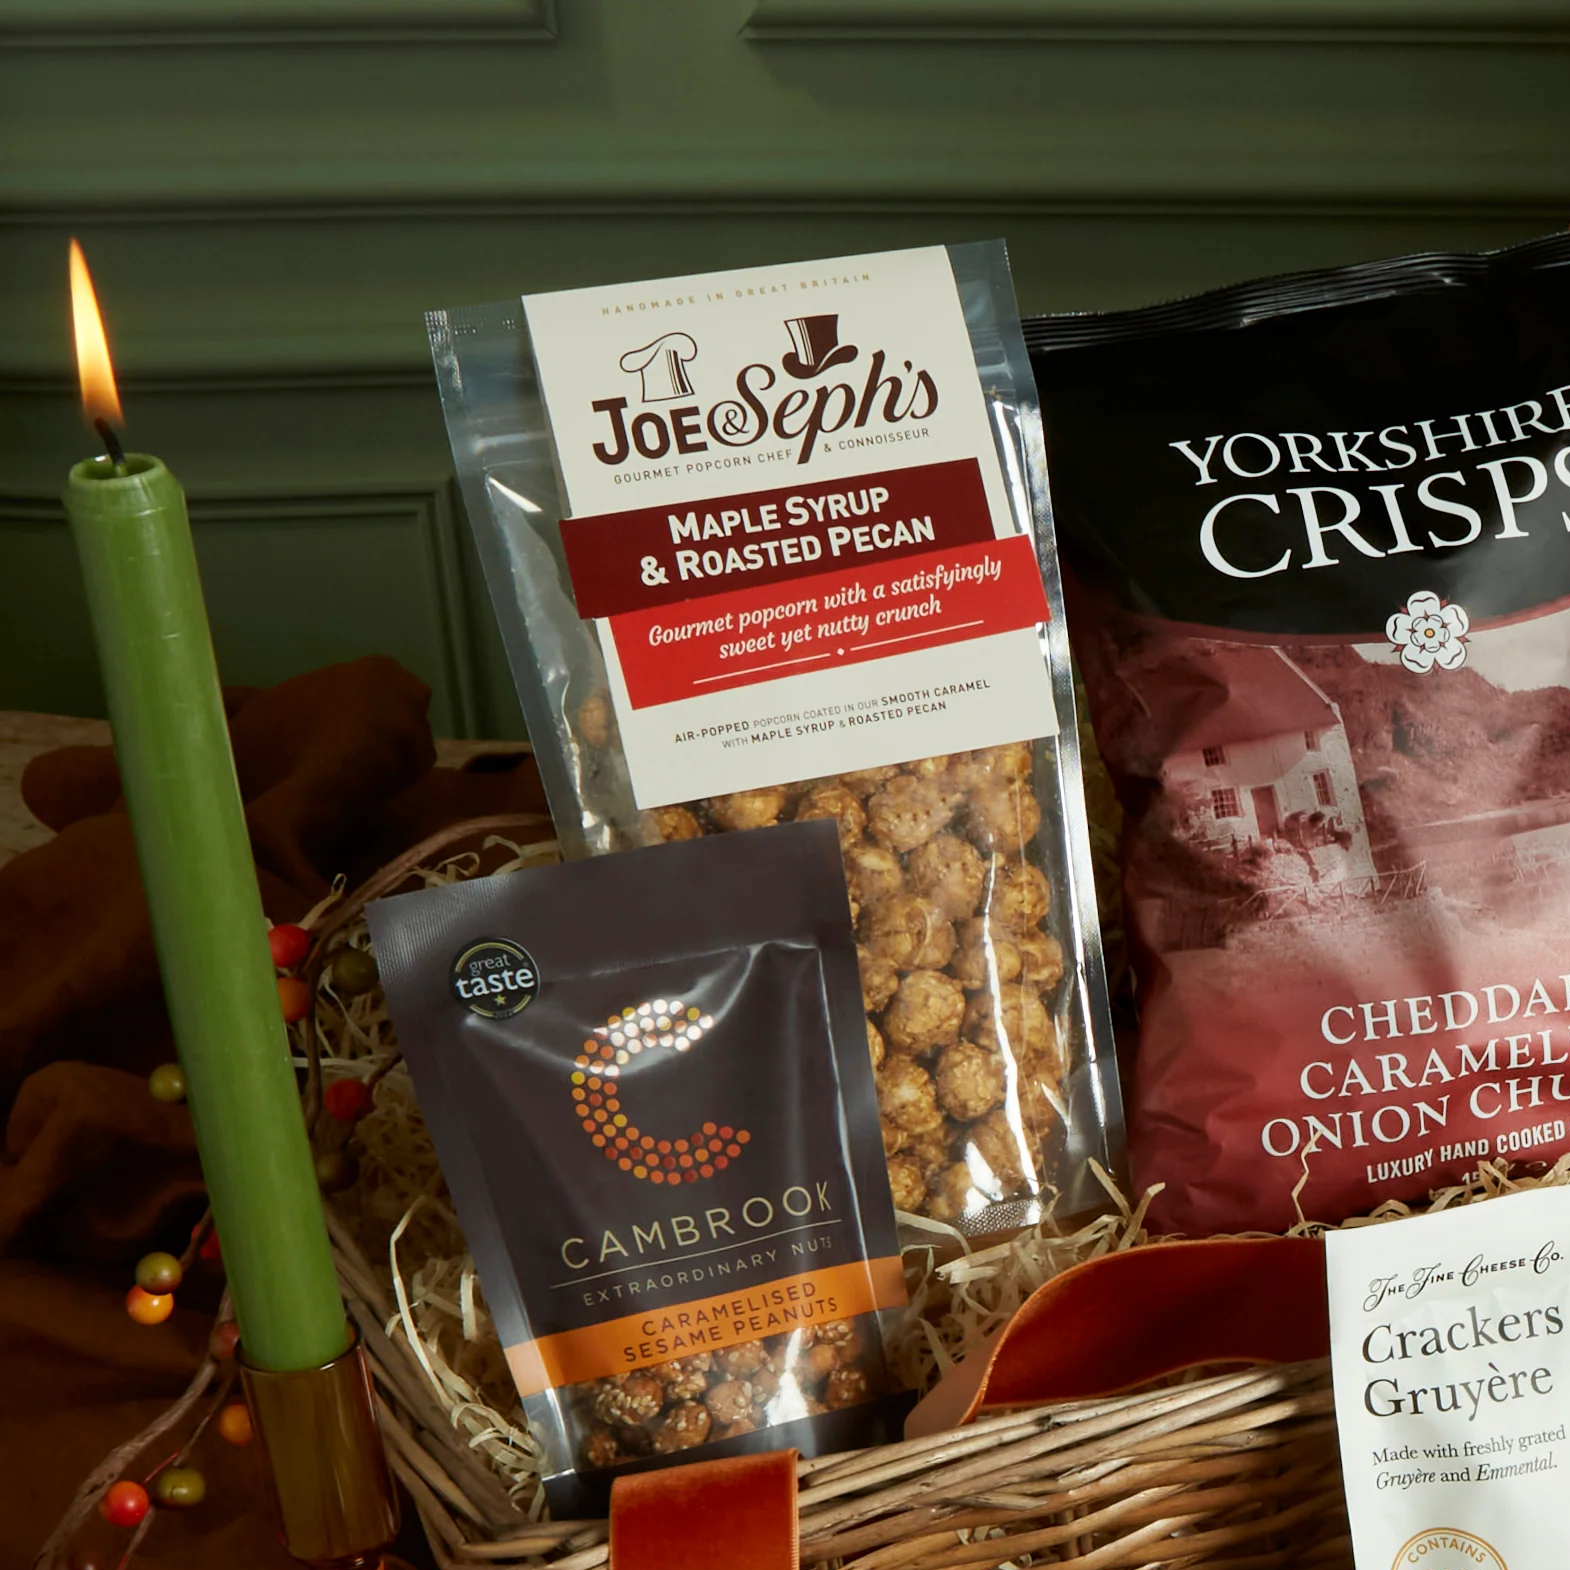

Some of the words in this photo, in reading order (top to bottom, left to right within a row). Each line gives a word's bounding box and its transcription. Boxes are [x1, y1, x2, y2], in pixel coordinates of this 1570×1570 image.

[601, 295, 696, 316] HANDMADE
[707, 292, 724, 303] IN
[800, 273, 870, 290] BRITAIN
[614, 466, 680, 485] GOURMET
[686, 456, 752, 474] POPCORN
[758, 449, 793, 463] CHEF
[824, 443, 832, 453] &
[838, 428, 931, 450] CONNOISSEUR
[640, 555, 670, 586] &
[649, 612, 734, 647] Gourmet
[738, 598, 818, 631] popcorn
[823, 583, 868, 610] with
[872, 584, 887, 600] a
[891, 555, 1003, 596] satisfyingly
[719, 635, 775, 660] sweet
[781, 626, 812, 652] yet
[817, 612, 870, 641] nutty
[875, 595, 942, 626] crunch
[674, 720, 750, 744] AIR-POPPED
[753, 711, 801, 729] POPCORN
[803, 704, 842, 720] COATED
[844, 702, 855, 713] IN
[857, 699, 879, 711] OUR
[881, 689, 931, 707] SMOOTH
[933, 678, 991, 697] CARAMEL
[722, 735, 749, 749] WITH
[751, 727, 793, 744] MAPLE
[796, 719, 836, 736] SYRUP
[839, 719, 847, 728] &
[849, 707, 904, 727] ROASTED
[906, 700, 947, 716] PECAN
[455, 968, 535, 999] taste
[469, 953, 512, 977] great
[1261, 1094, 1451, 1158] ONION
[1366, 1148, 1434, 1184] LUXURY
[1440, 1137, 1489, 1162] HAND
[1495, 1120, 1566, 1154] COOKED
[560, 1181, 832, 1270] CAMBROOK
[583, 1249, 778, 1307] EXTRAORDINARY
[790, 1236, 833, 1257] NUTS
[623, 1325, 723, 1363] SESAME
[733, 1297, 838, 1336] PEANUTS
[642, 1282, 817, 1337] CARAMELISED
[1361, 1305, 1564, 1364] Crackers
[1364, 1362, 1554, 1422] Gruyère
[1372, 1444, 1419, 1465] Made
[1422, 1442, 1459, 1459] with
[1463, 1435, 1514, 1457] freshly
[1518, 1424, 1567, 1452] grated
[1376, 1467, 1436, 1490] Gruyère
[1440, 1466, 1471, 1482] and
[1475, 1451, 1558, 1482] Emmental.
[1407, 1536, 1487, 1564] CONTAINS
